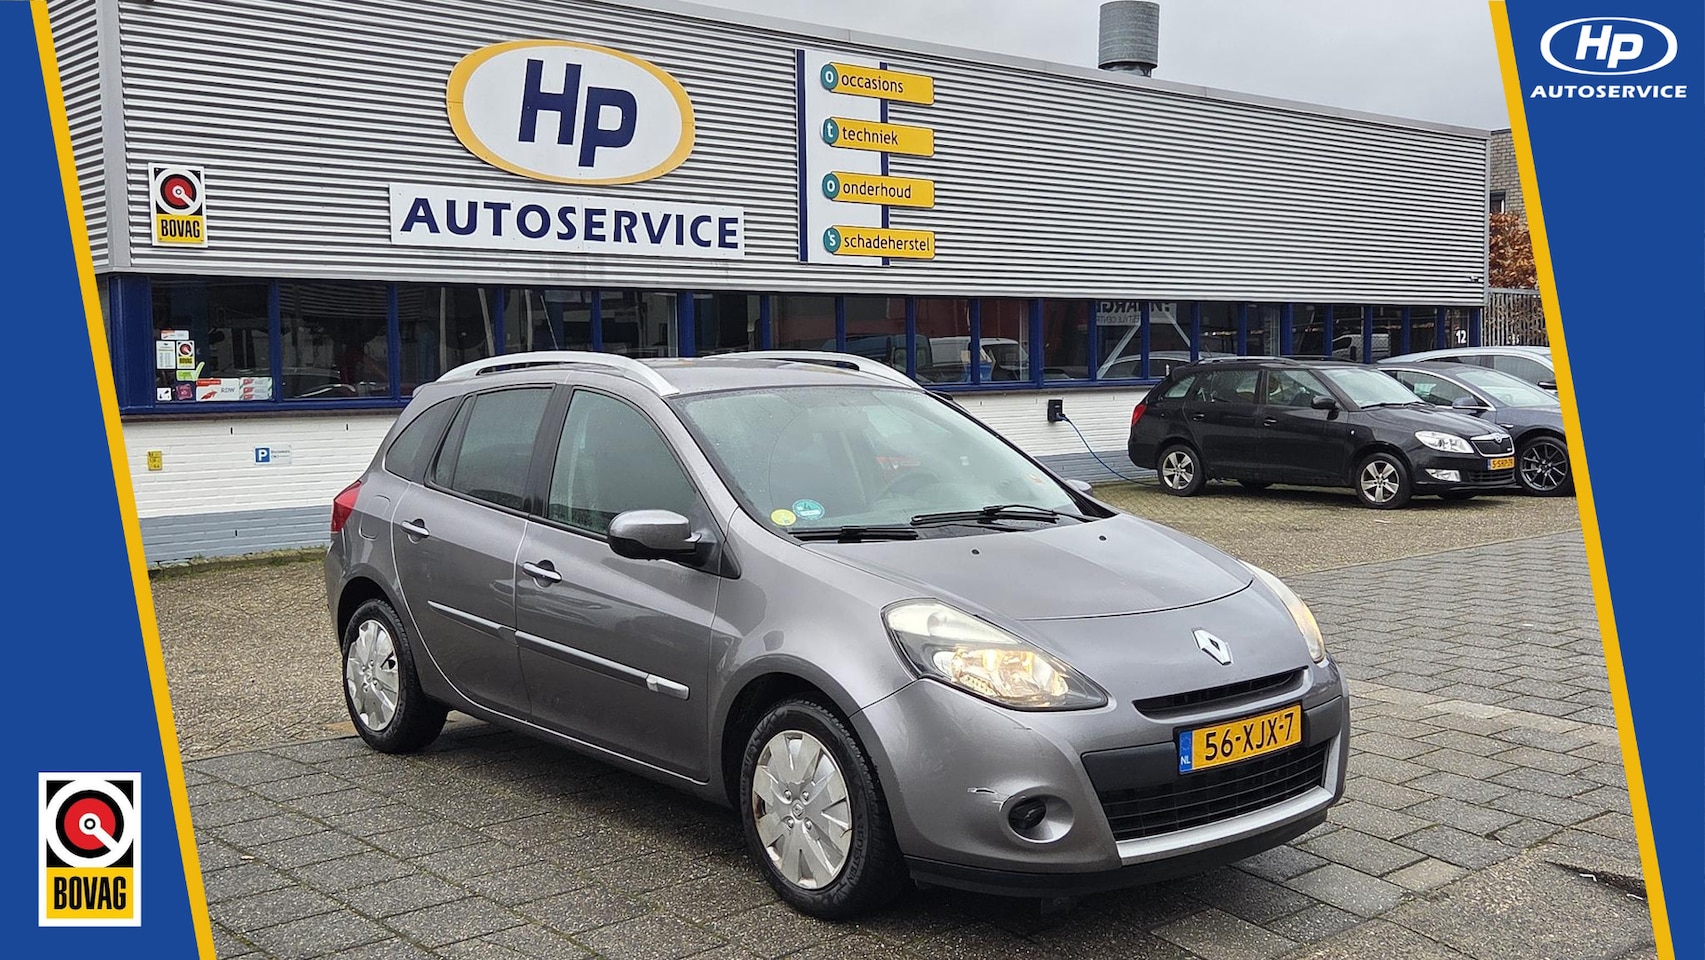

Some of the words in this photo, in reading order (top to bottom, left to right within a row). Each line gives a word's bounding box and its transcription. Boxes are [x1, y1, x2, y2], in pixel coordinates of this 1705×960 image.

[841, 74, 904, 93] occasions
[518, 58, 637, 168] Hp
[842, 126, 899, 145] techniek
[843, 181, 912, 199] onderhoud
[161, 219, 200, 238] BOVAG
[400, 197, 740, 249] AUTOSERVICE
[844, 234, 930, 251] schadeherstel
[1456, 329, 1467, 344] 12
[259, 450, 268, 461] P
[1205, 712, 1294, 761] 56-XJX-7
[1180, 756, 1191, 765] NL
